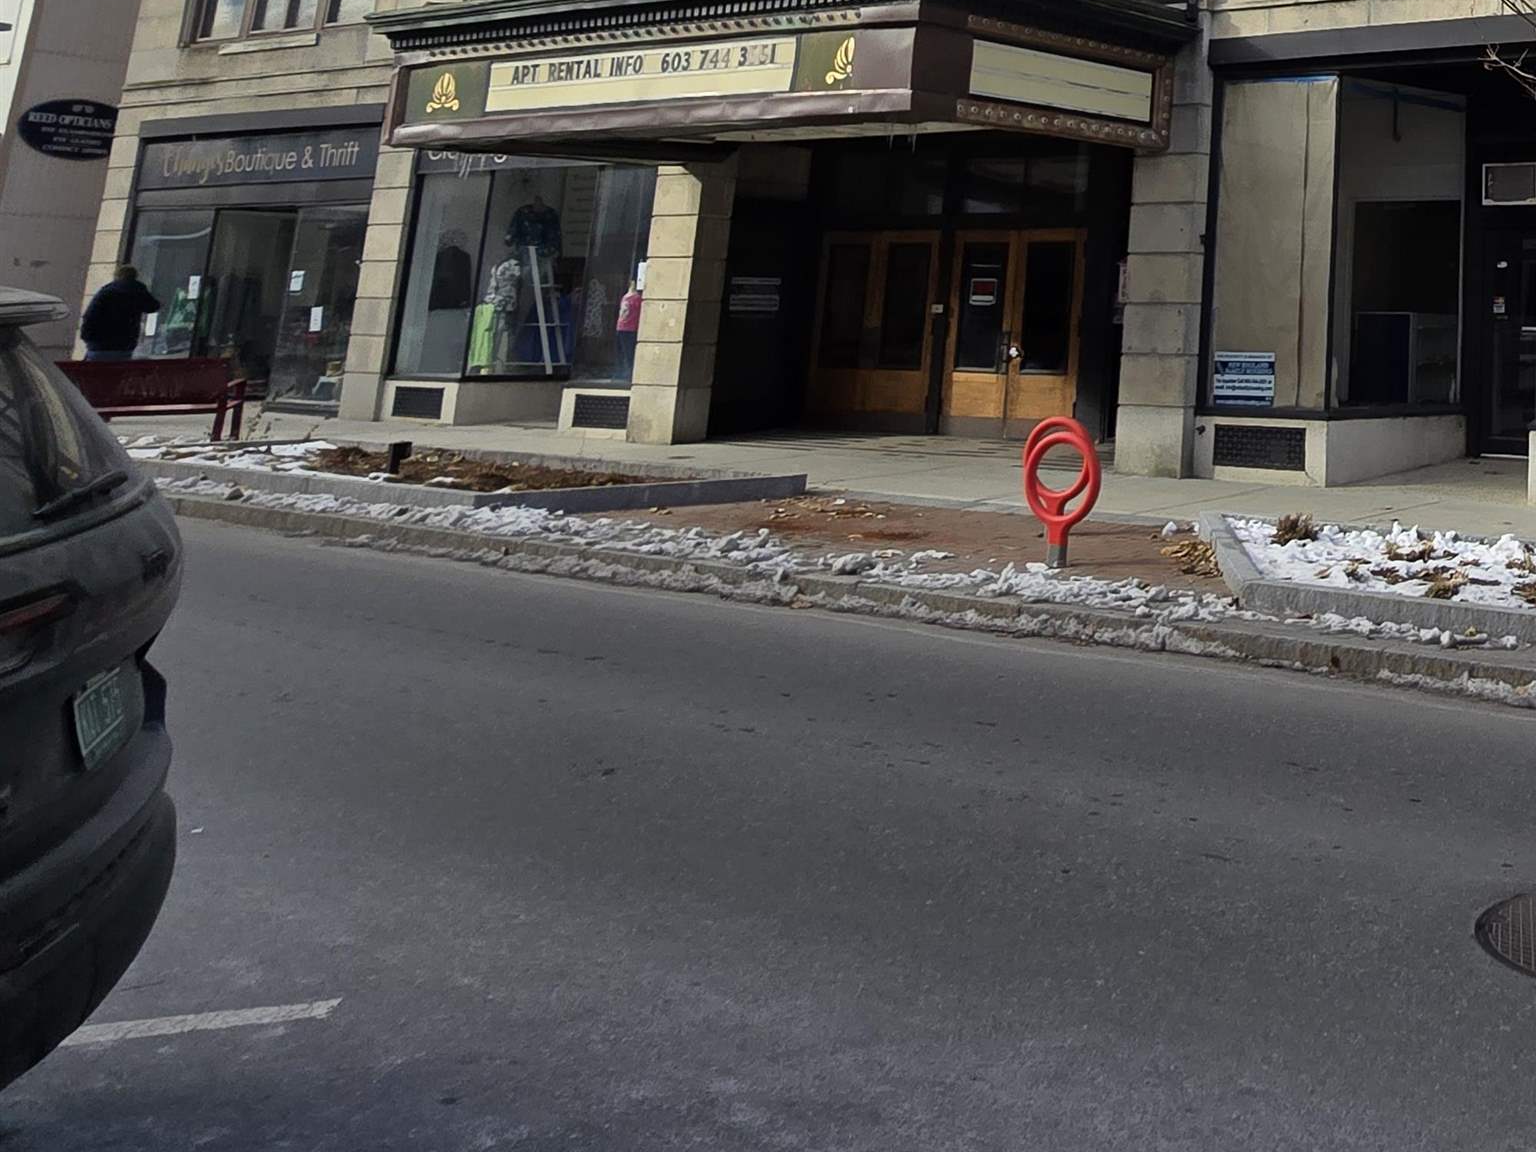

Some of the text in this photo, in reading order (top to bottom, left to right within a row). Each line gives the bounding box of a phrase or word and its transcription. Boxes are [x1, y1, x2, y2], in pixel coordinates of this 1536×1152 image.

[511, 64, 540, 85] APT
[548, 59, 601, 82] RENTAL
[609, 55, 643, 77] INFO
[661, 51, 691, 73] 603
[699, 48, 731, 69] 744
[224, 149, 297, 174] Boutique
[301, 146, 314, 169] &
[319, 141, 360, 168] Thrift
